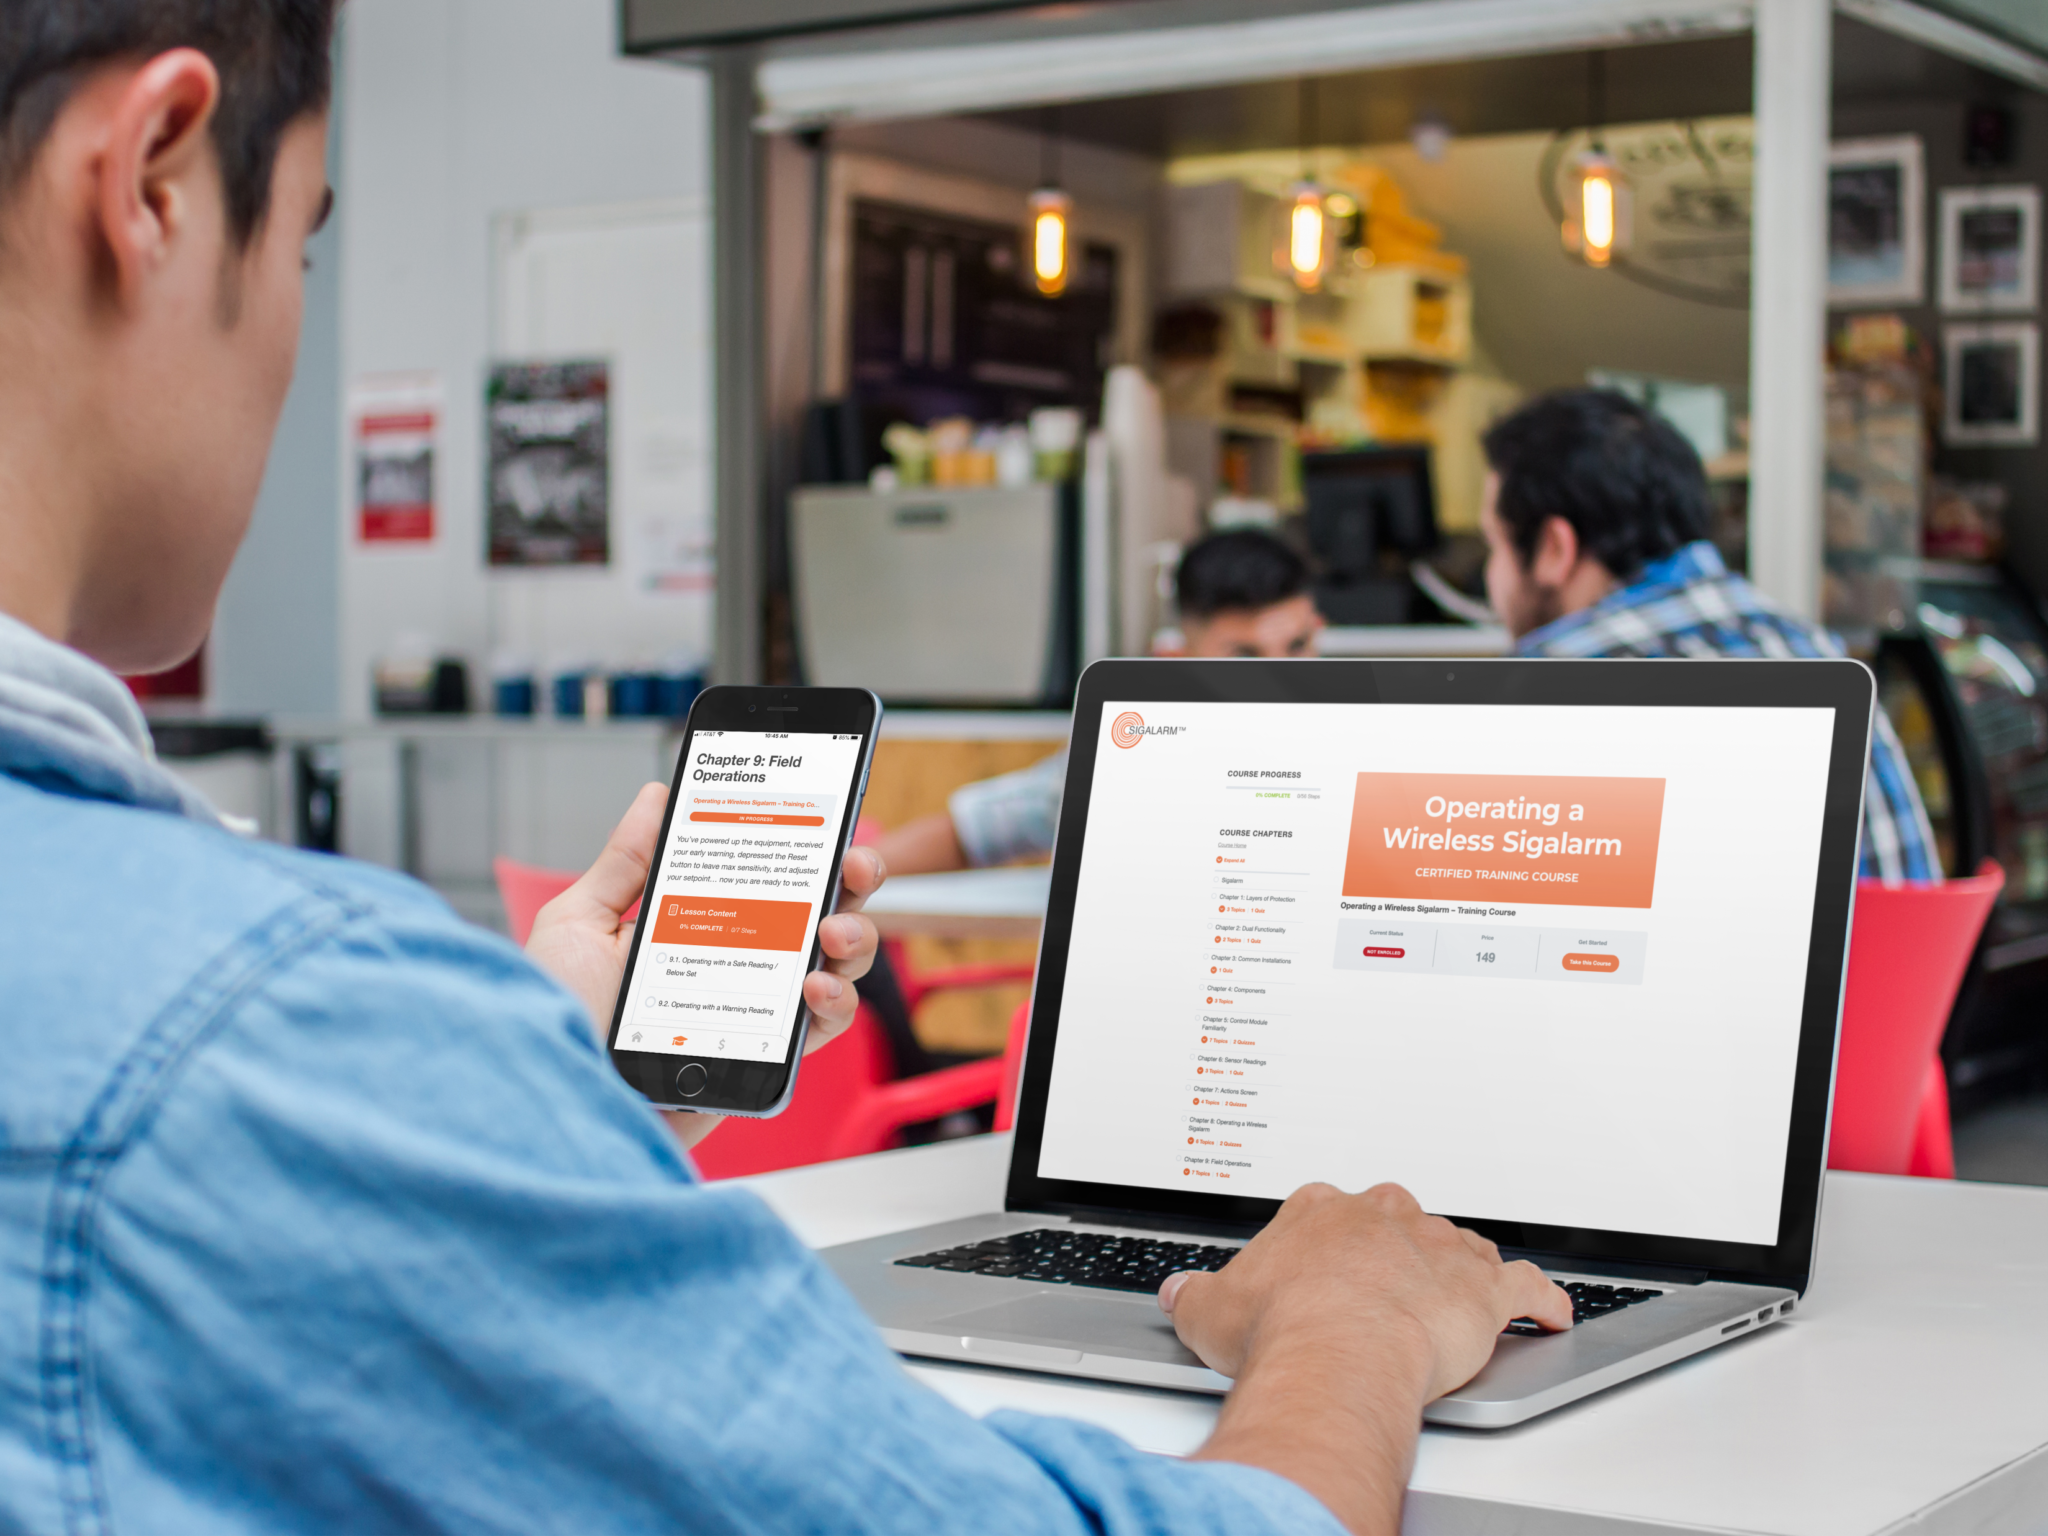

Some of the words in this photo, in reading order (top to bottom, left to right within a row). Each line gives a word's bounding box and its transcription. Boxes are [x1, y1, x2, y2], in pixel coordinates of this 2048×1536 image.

[697, 753, 750, 768] Chapter
[753, 755, 765, 767] 9:
[769, 755, 802, 768] Field
[693, 769, 766, 783] Operations
[1425, 796, 1560, 826] Operating
[1569, 804, 1585, 821] a
[1253, 830, 1293, 838] CHAPTERS
[700, 837, 730, 845] powered
[754, 840, 792, 848] equipment,
[1383, 826, 1494, 852] Wireless
[1502, 829, 1623, 859] Sigalarm
[707, 850, 736, 859] warning,
[737, 852, 773, 860] depressed
[702, 862, 719, 870] leave
[737, 864, 772, 873] sensitivity,
[789, 867, 819, 875] adjusted
[1415, 867, 1472, 879] CERTIFIED
[1475, 869, 1529, 881] TRAINING
[1532, 871, 1579, 883] COURSE
[762, 879, 781, 887] ready
[680, 908, 706, 916] Lesson
[708, 909, 737, 918] Content
[1340, 902, 1376, 911] Operating
[1384, 904, 1415, 912] Wireless
[1417, 905, 1449, 914] Sigalarm
[1457, 907, 1487, 916] Training
[1489, 908, 1516, 917] Course
[1255, 926, 1286, 934] Functionality
[1476, 952, 1496, 963] 149
[682, 957, 712, 966] Operating
[748, 961, 774, 970] Reading
[671, 1001, 701, 1010] Operating
[722, 1005, 747, 1014] Warning
[748, 1007, 774, 1016] Reading
[1249, 1018, 1268, 1026] Module
[1202, 1024, 1227, 1032] Familiarity
[1243, 1058, 1266, 1066] Readings
[1190, 1116, 1209, 1124] Chapter
[1216, 1119, 1241, 1127] Operating
[1188, 1125, 1210, 1133] Sigalarm
